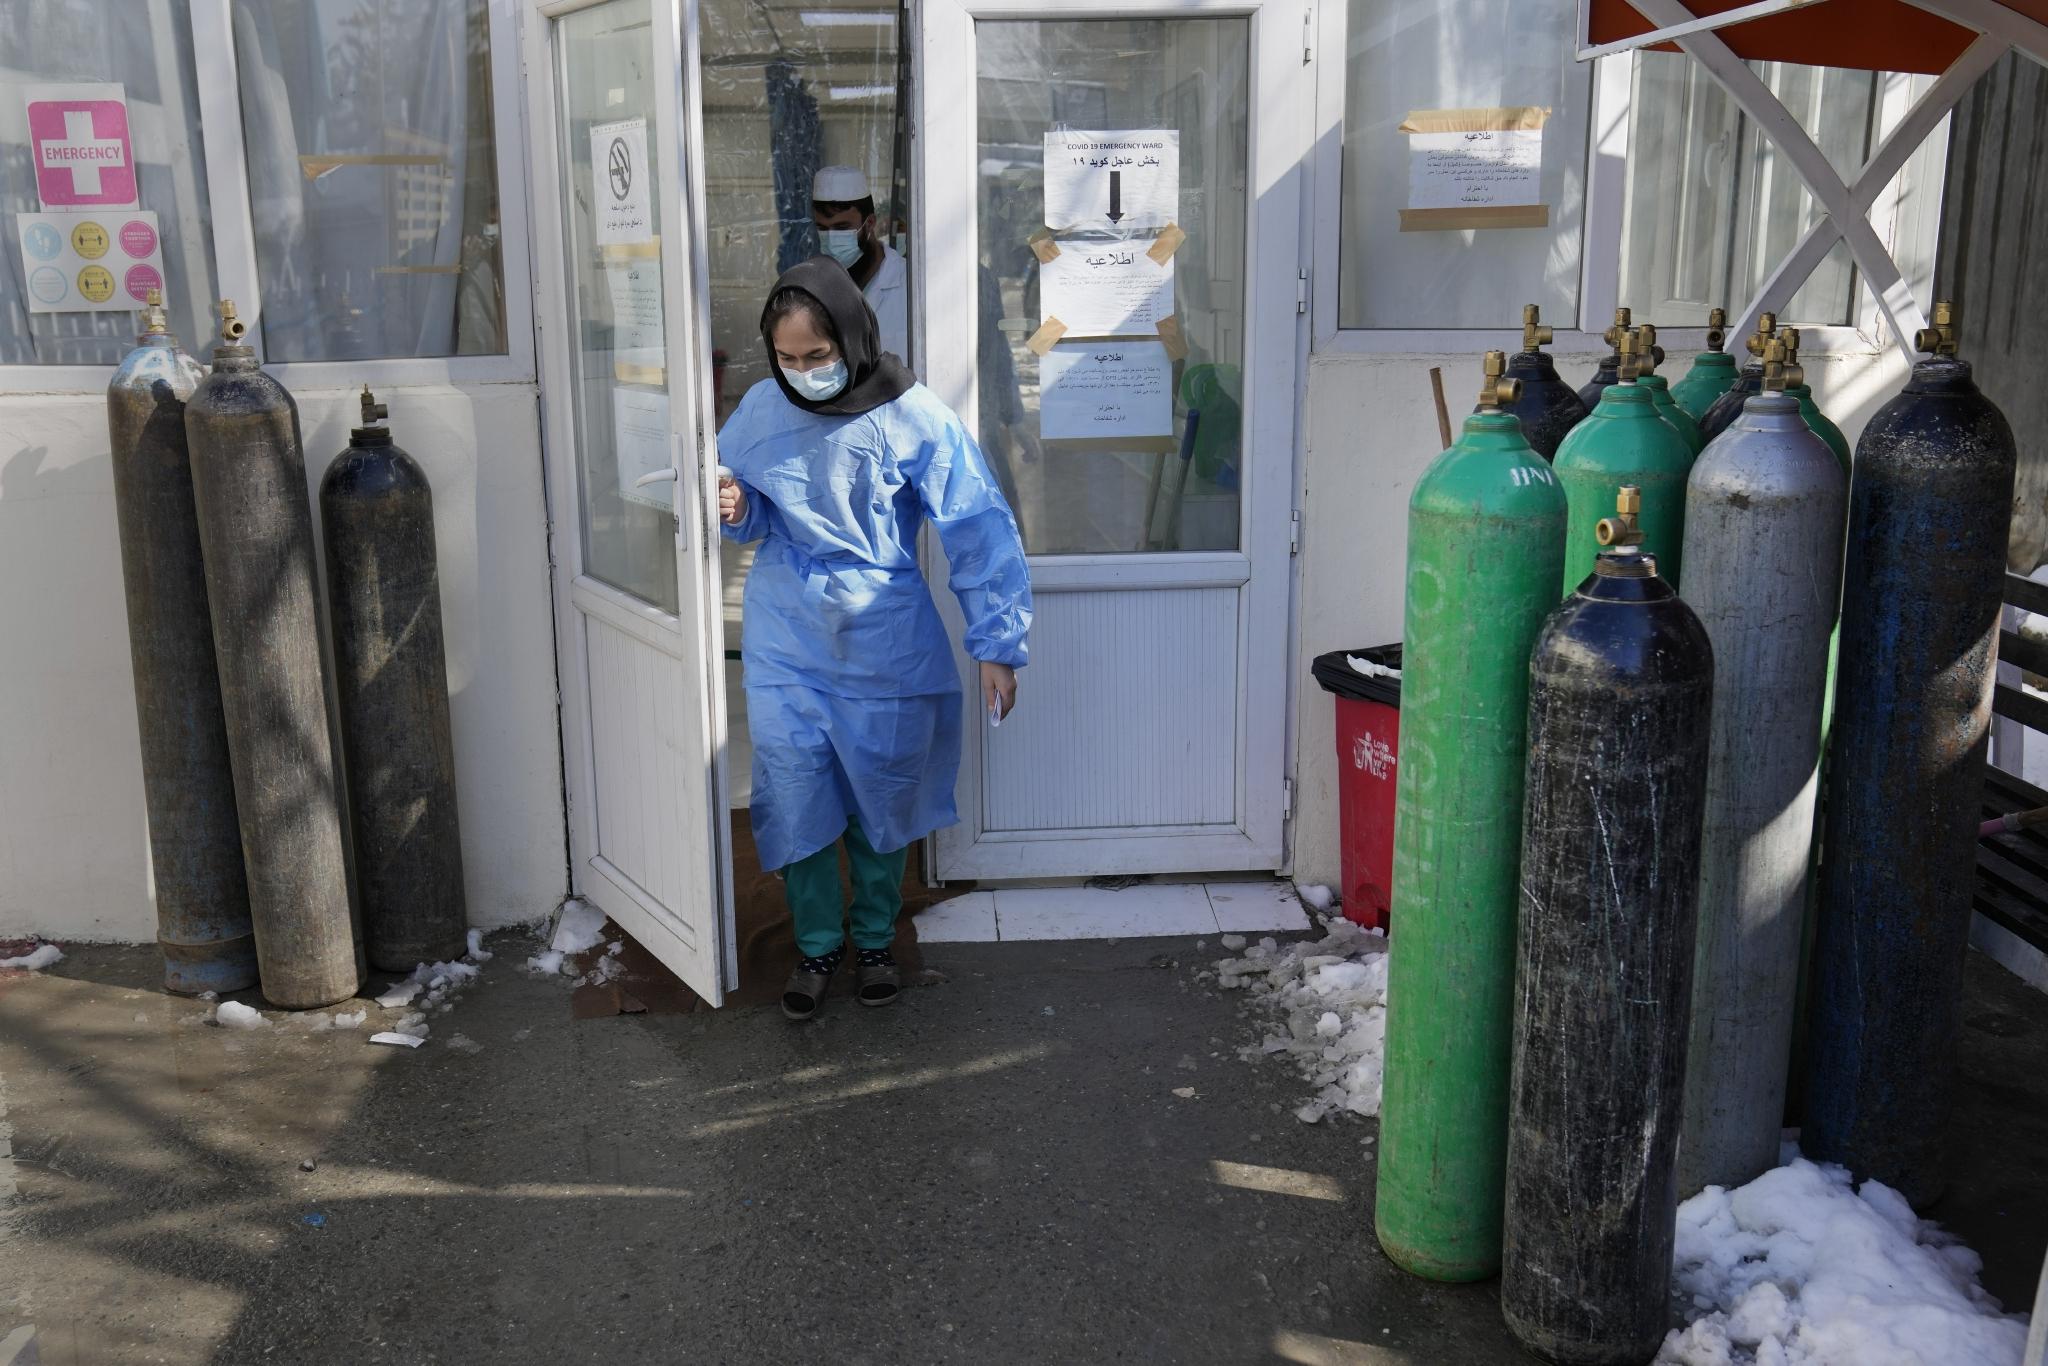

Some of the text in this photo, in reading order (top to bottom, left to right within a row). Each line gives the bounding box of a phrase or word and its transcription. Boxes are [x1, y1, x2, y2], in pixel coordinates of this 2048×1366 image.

[1464, 132, 1494, 143] اطلاعیه
[1099, 142, 1140, 150] EMERGENCY
[45, 146, 120, 161] EMERGENCY
[1111, 156, 1134, 168] عاجل
[1137, 155, 1160, 168] بخش
[1085, 252, 1135, 269] اطلاعیه
[1093, 353, 1124, 363] اطلاعیه
[1373, 739, 1389, 753] Love
